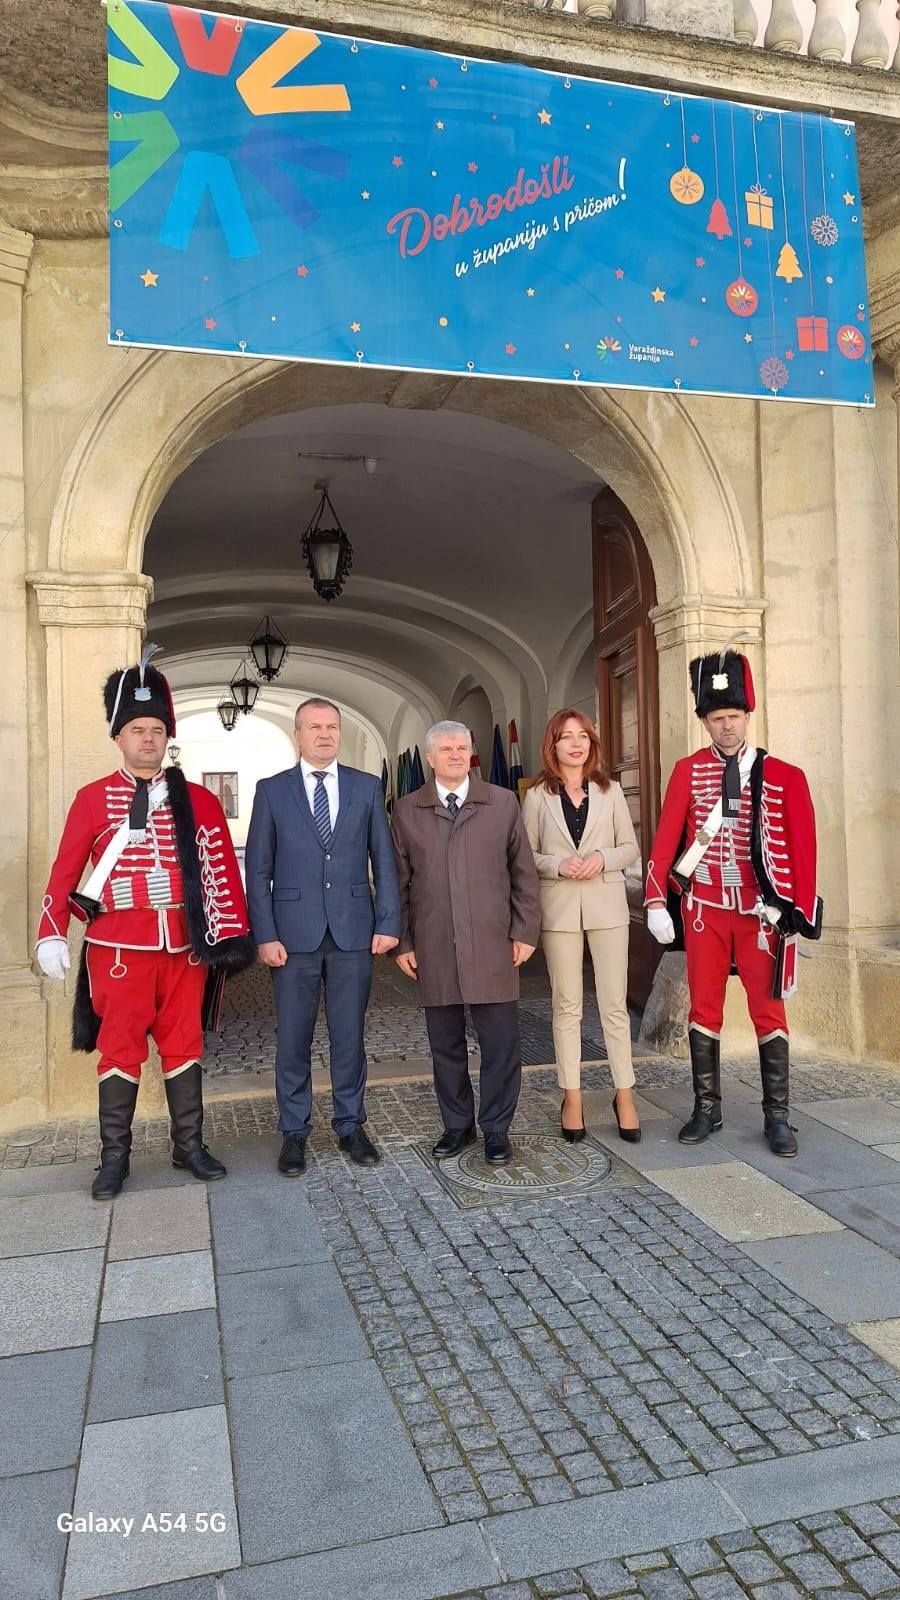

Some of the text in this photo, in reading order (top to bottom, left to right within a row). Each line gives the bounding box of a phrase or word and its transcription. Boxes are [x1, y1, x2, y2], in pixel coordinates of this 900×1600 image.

[386, 155, 576, 258] Dobrodošli
[455, 259, 468, 278] u
[473, 220, 548, 268] županiju
[552, 215, 560, 231] s
[628, 343, 674, 357] Varaždinska
[629, 351, 660, 363] županija
